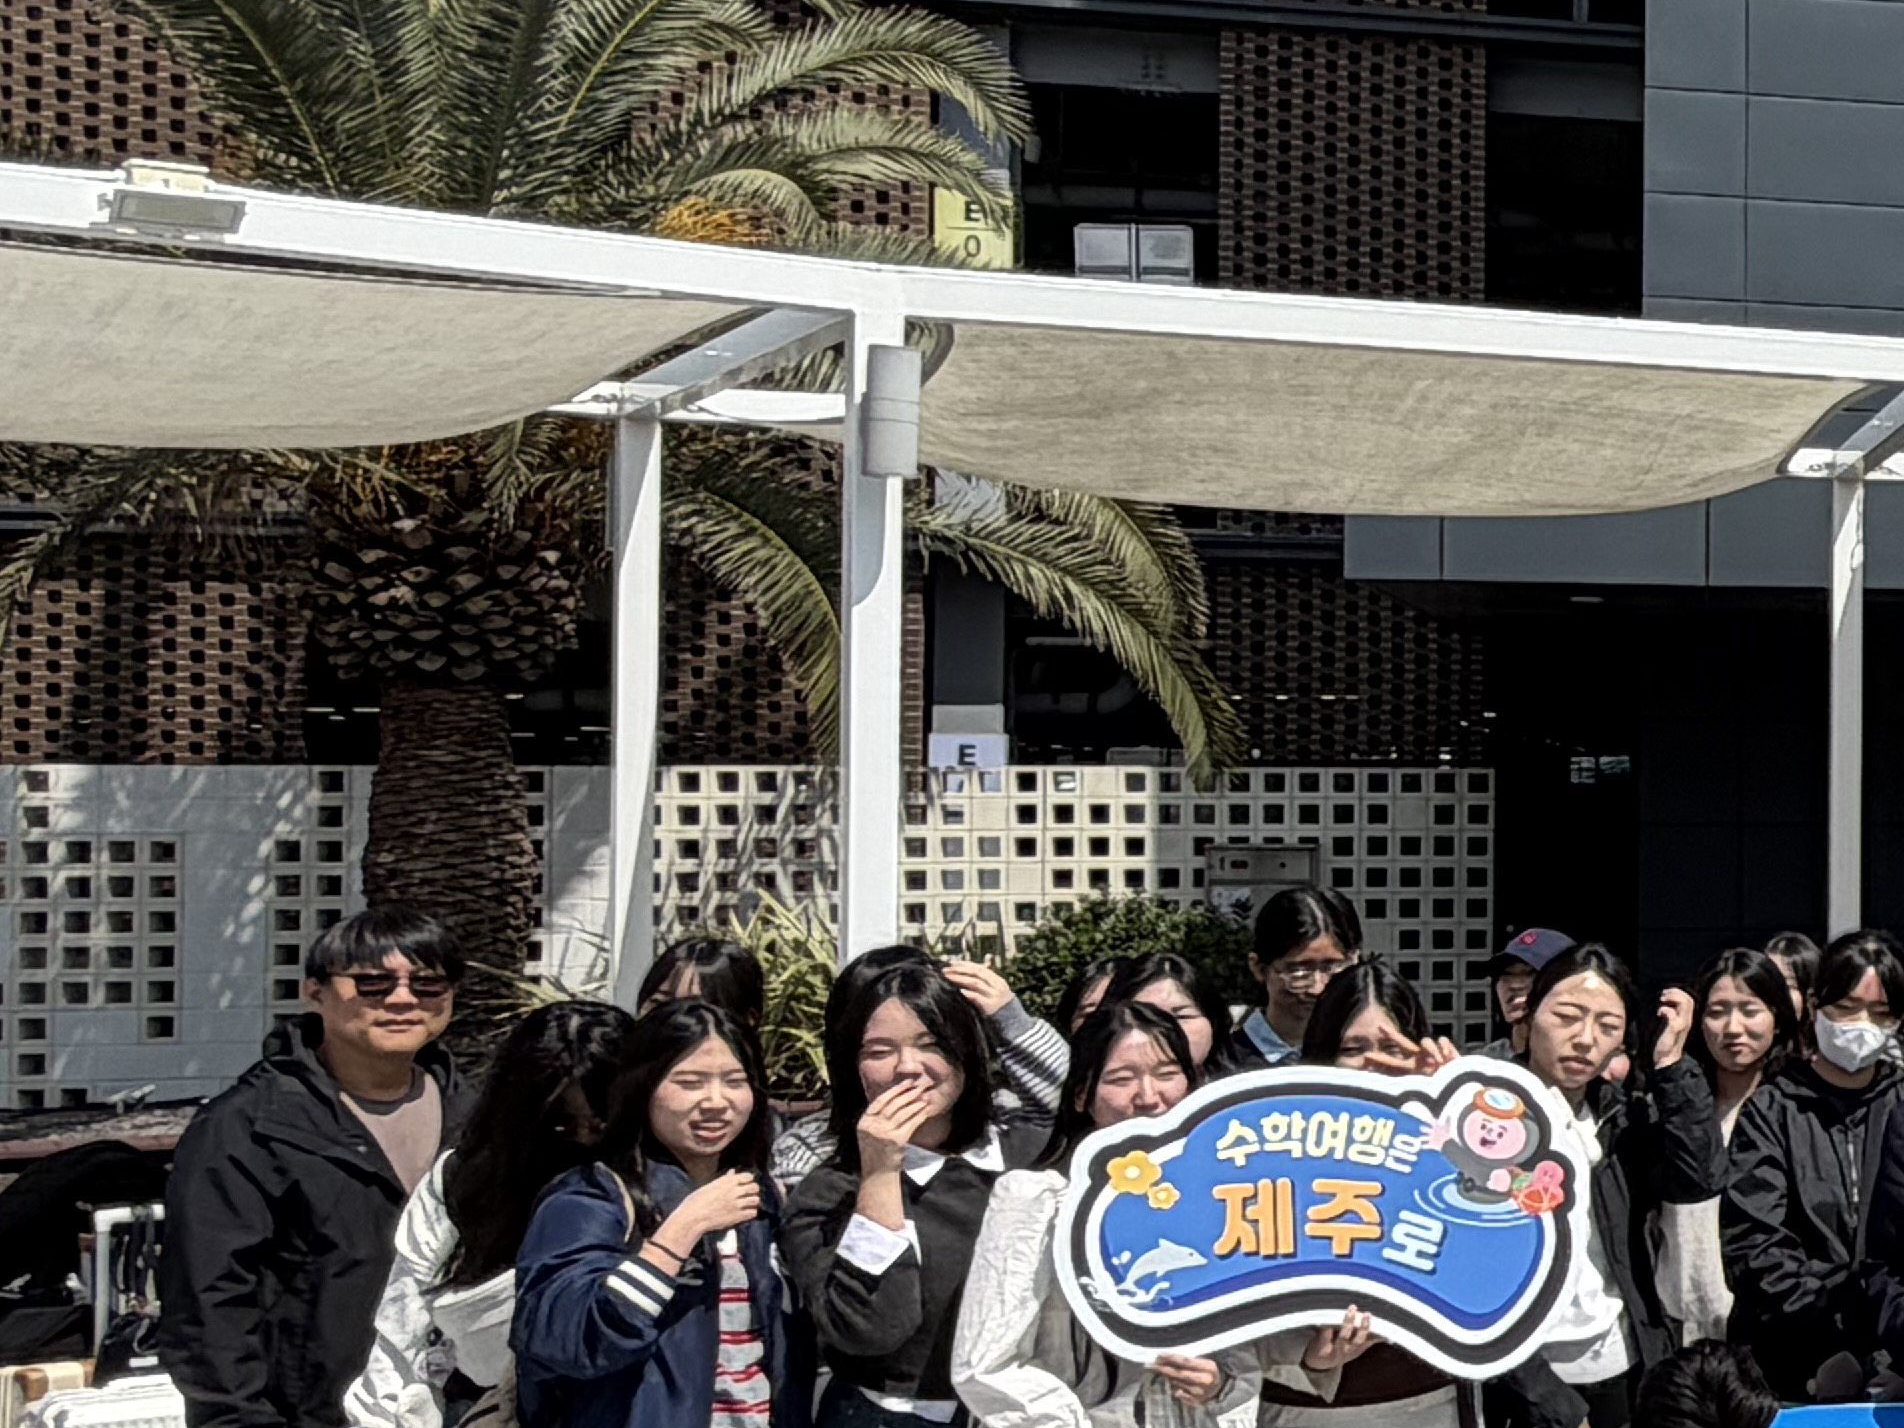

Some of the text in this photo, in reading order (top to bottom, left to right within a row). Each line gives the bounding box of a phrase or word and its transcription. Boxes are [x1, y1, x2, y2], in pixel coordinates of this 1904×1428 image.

[964, 200, 982, 222] E
[957, 744, 977, 766] E
[1216, 1110, 1422, 1174] 수학여행은
[1213, 1176, 1446, 1273] 제주로
